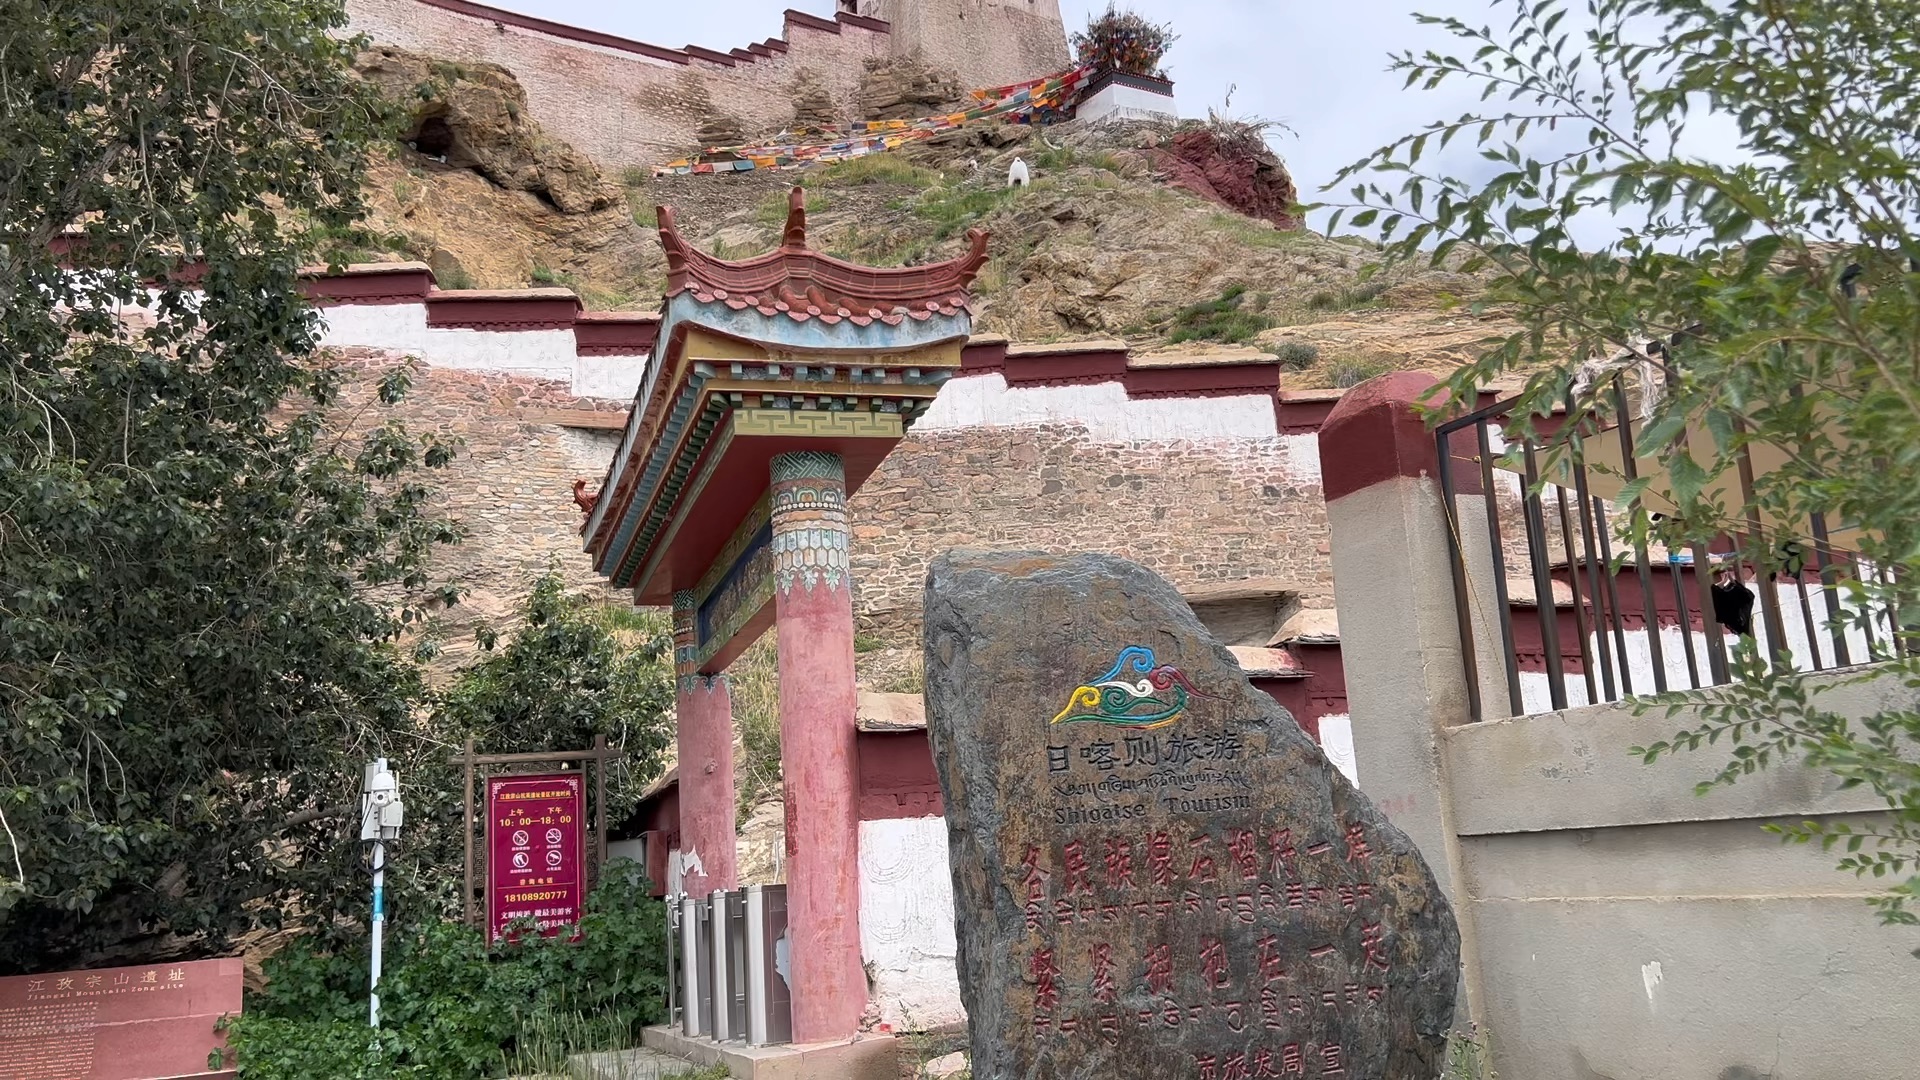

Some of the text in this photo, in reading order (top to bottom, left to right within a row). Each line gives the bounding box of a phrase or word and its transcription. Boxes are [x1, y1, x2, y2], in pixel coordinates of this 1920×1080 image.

[1046, 728, 1242, 772] 日喀则旅游
[508, 806, 563, 817] 上午 下午
[1055, 794, 1251, 825] Shigatse Tourism
[1020, 820, 1375, 901] 各民族像石榴籽一样
[504, 890, 568, 903] 18108920777
[76, 987, 127, 997] Mountain
